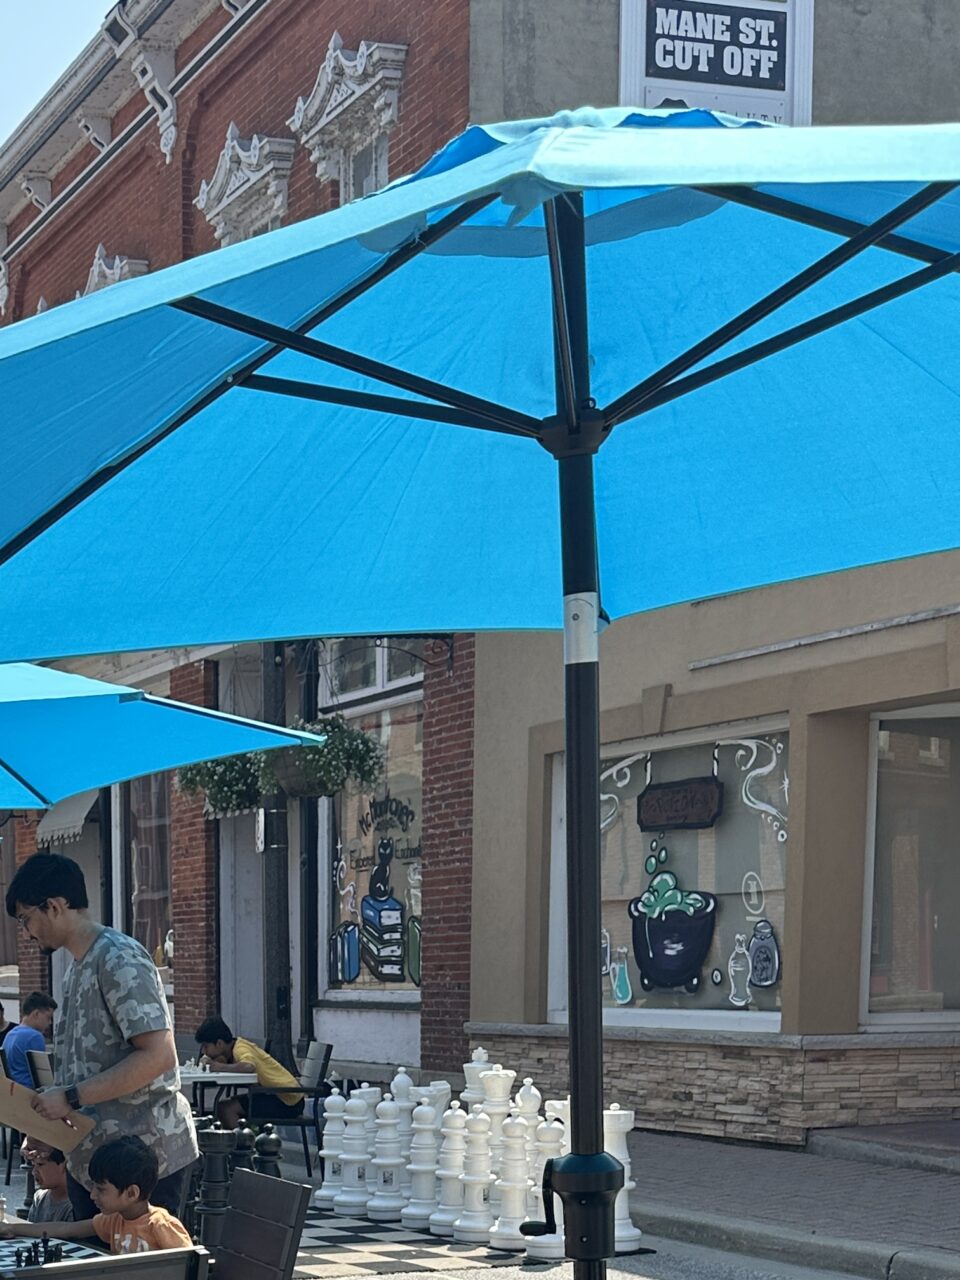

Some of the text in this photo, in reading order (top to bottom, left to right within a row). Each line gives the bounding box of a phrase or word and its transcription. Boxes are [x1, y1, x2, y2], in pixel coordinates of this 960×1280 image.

[655, 7, 778, 47] MANE ST.
[655, 38, 778, 79] CUT OFF
